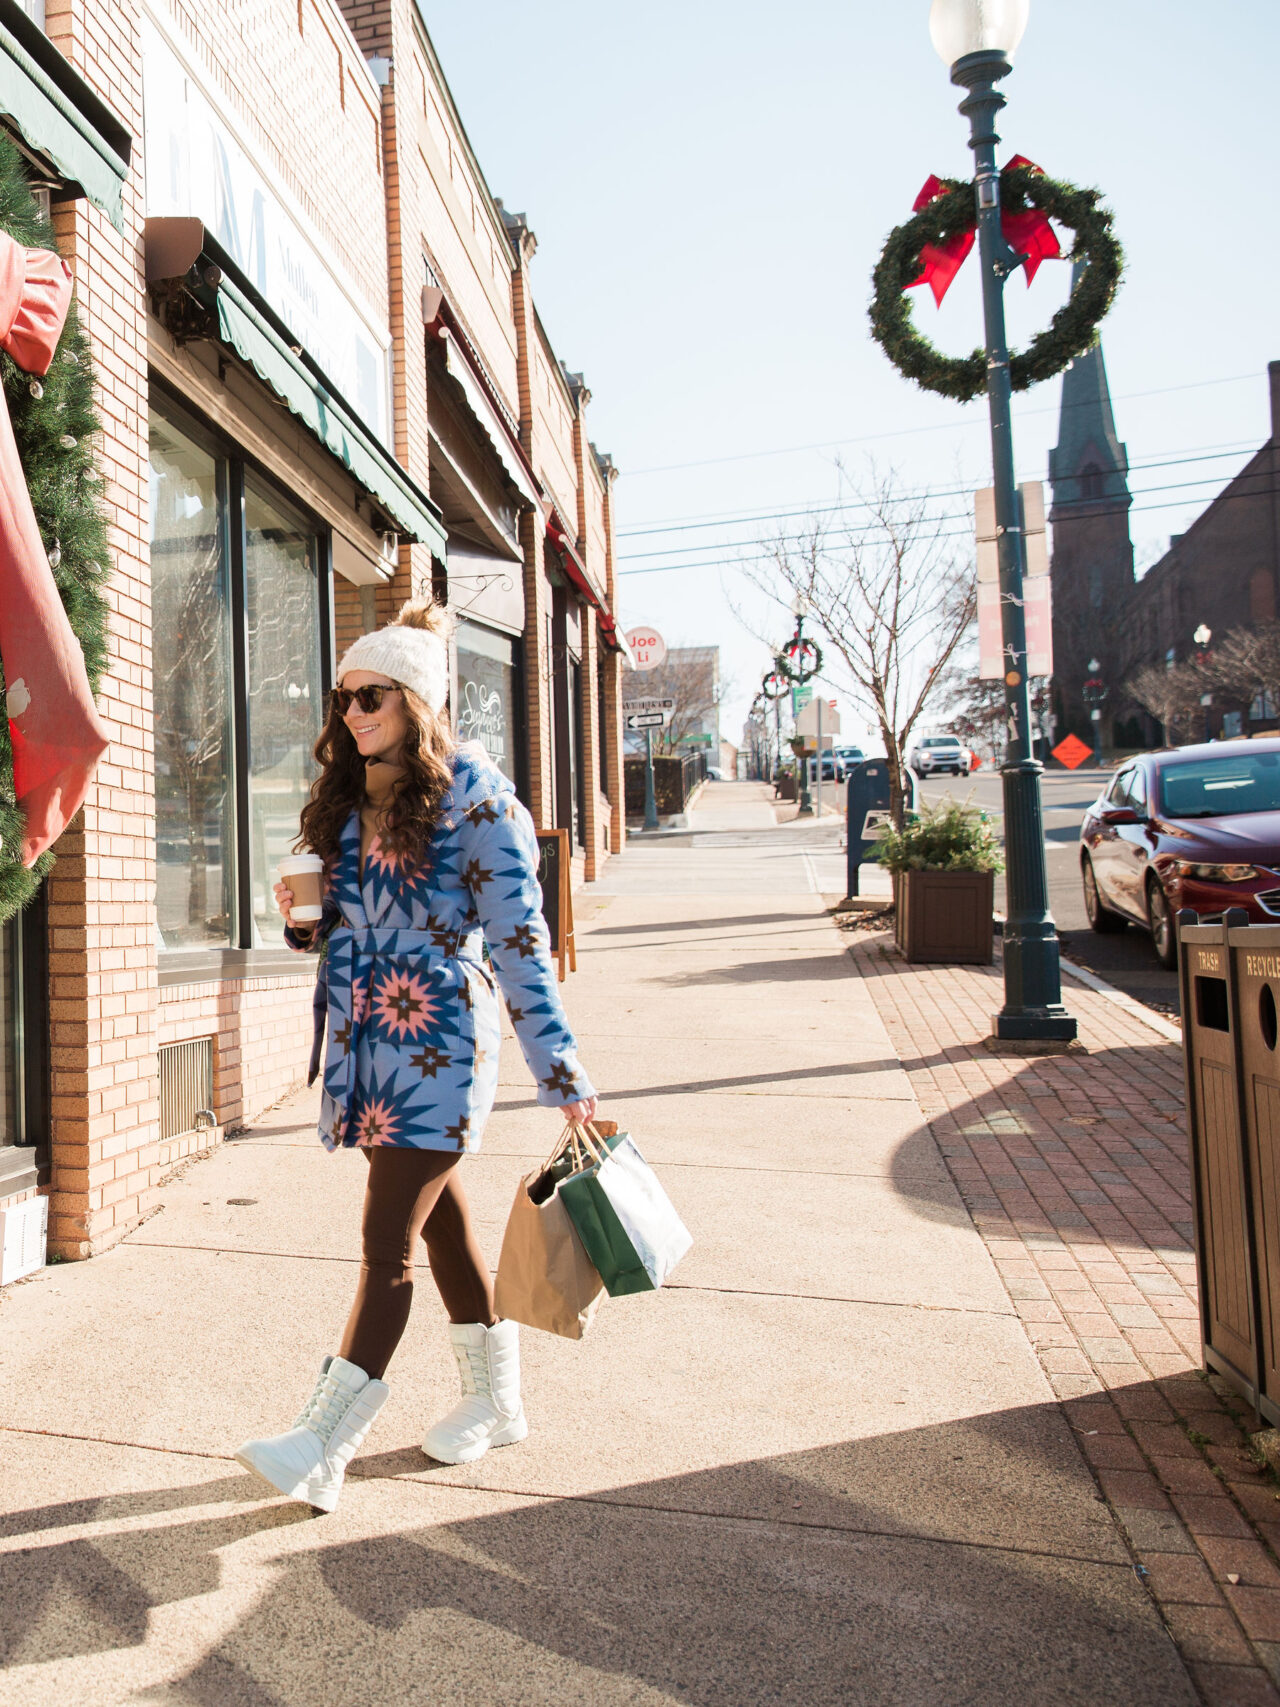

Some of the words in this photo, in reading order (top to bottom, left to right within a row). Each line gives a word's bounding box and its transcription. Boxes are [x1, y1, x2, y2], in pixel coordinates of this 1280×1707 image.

[630, 636, 657, 648] Joe
[637, 651, 649, 663] Li
[1198, 951, 1220, 971] TRASH
